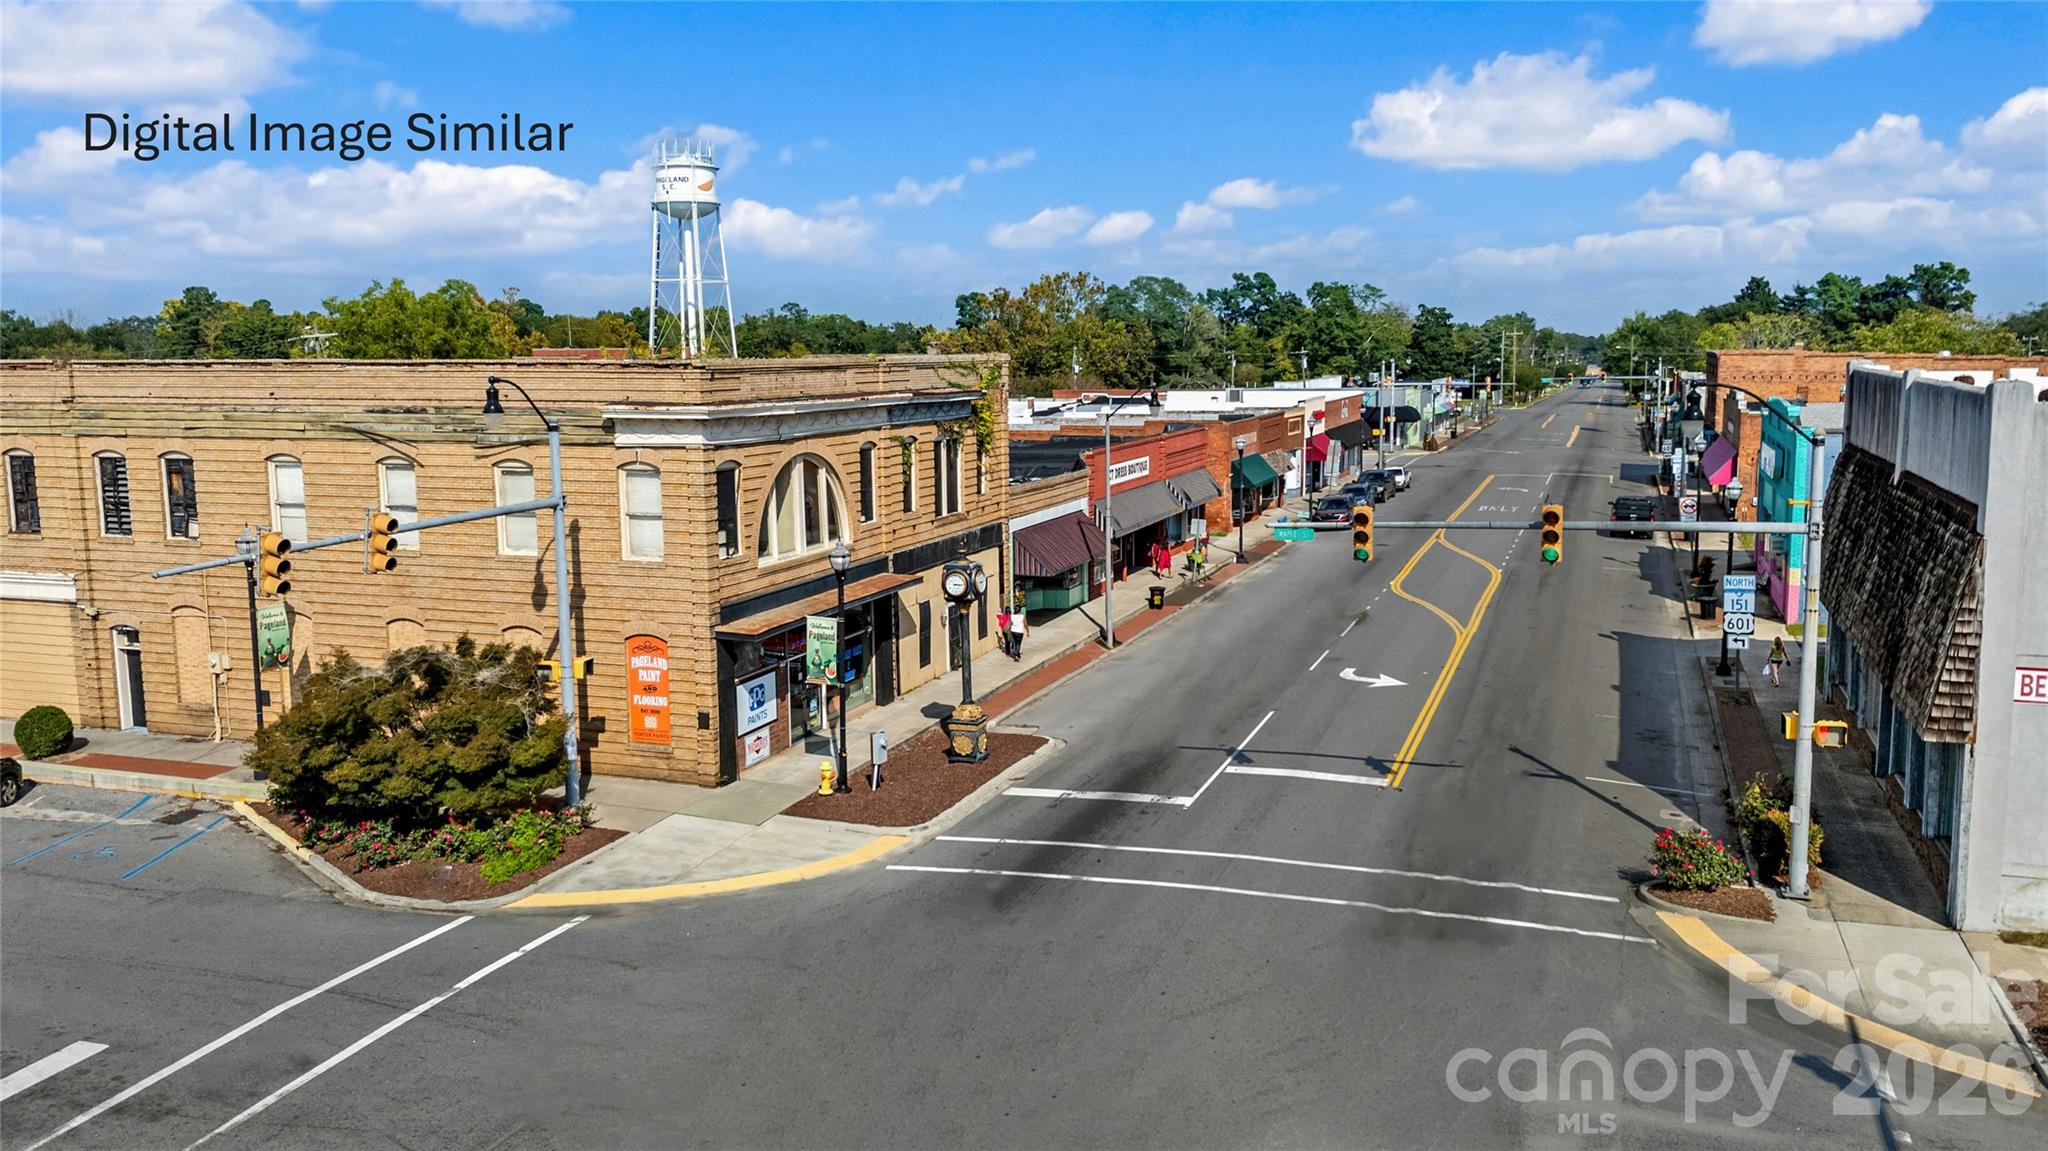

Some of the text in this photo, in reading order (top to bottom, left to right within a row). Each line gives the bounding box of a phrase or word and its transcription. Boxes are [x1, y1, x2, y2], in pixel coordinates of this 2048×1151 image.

[1115, 465, 1128, 479] DRESS
[1128, 460, 1148, 476] BOUTIQUE
[1279, 530, 1297, 539] MAPLE
[1725, 578, 1754, 587] NORTH
[1731, 598, 1748, 611] 151
[260, 619, 287, 631] Pageland
[1727, 618, 1750, 630] 601
[808, 630, 836, 642] Pageland
[631, 655, 668, 670] PAGELAND
[639, 669, 662, 682] PAINT
[2019, 674, 2048, 698] BE
[633, 694, 668, 707] FLOORING
[749, 686, 765, 708] PPG
[747, 709, 768, 726] PAINTS
